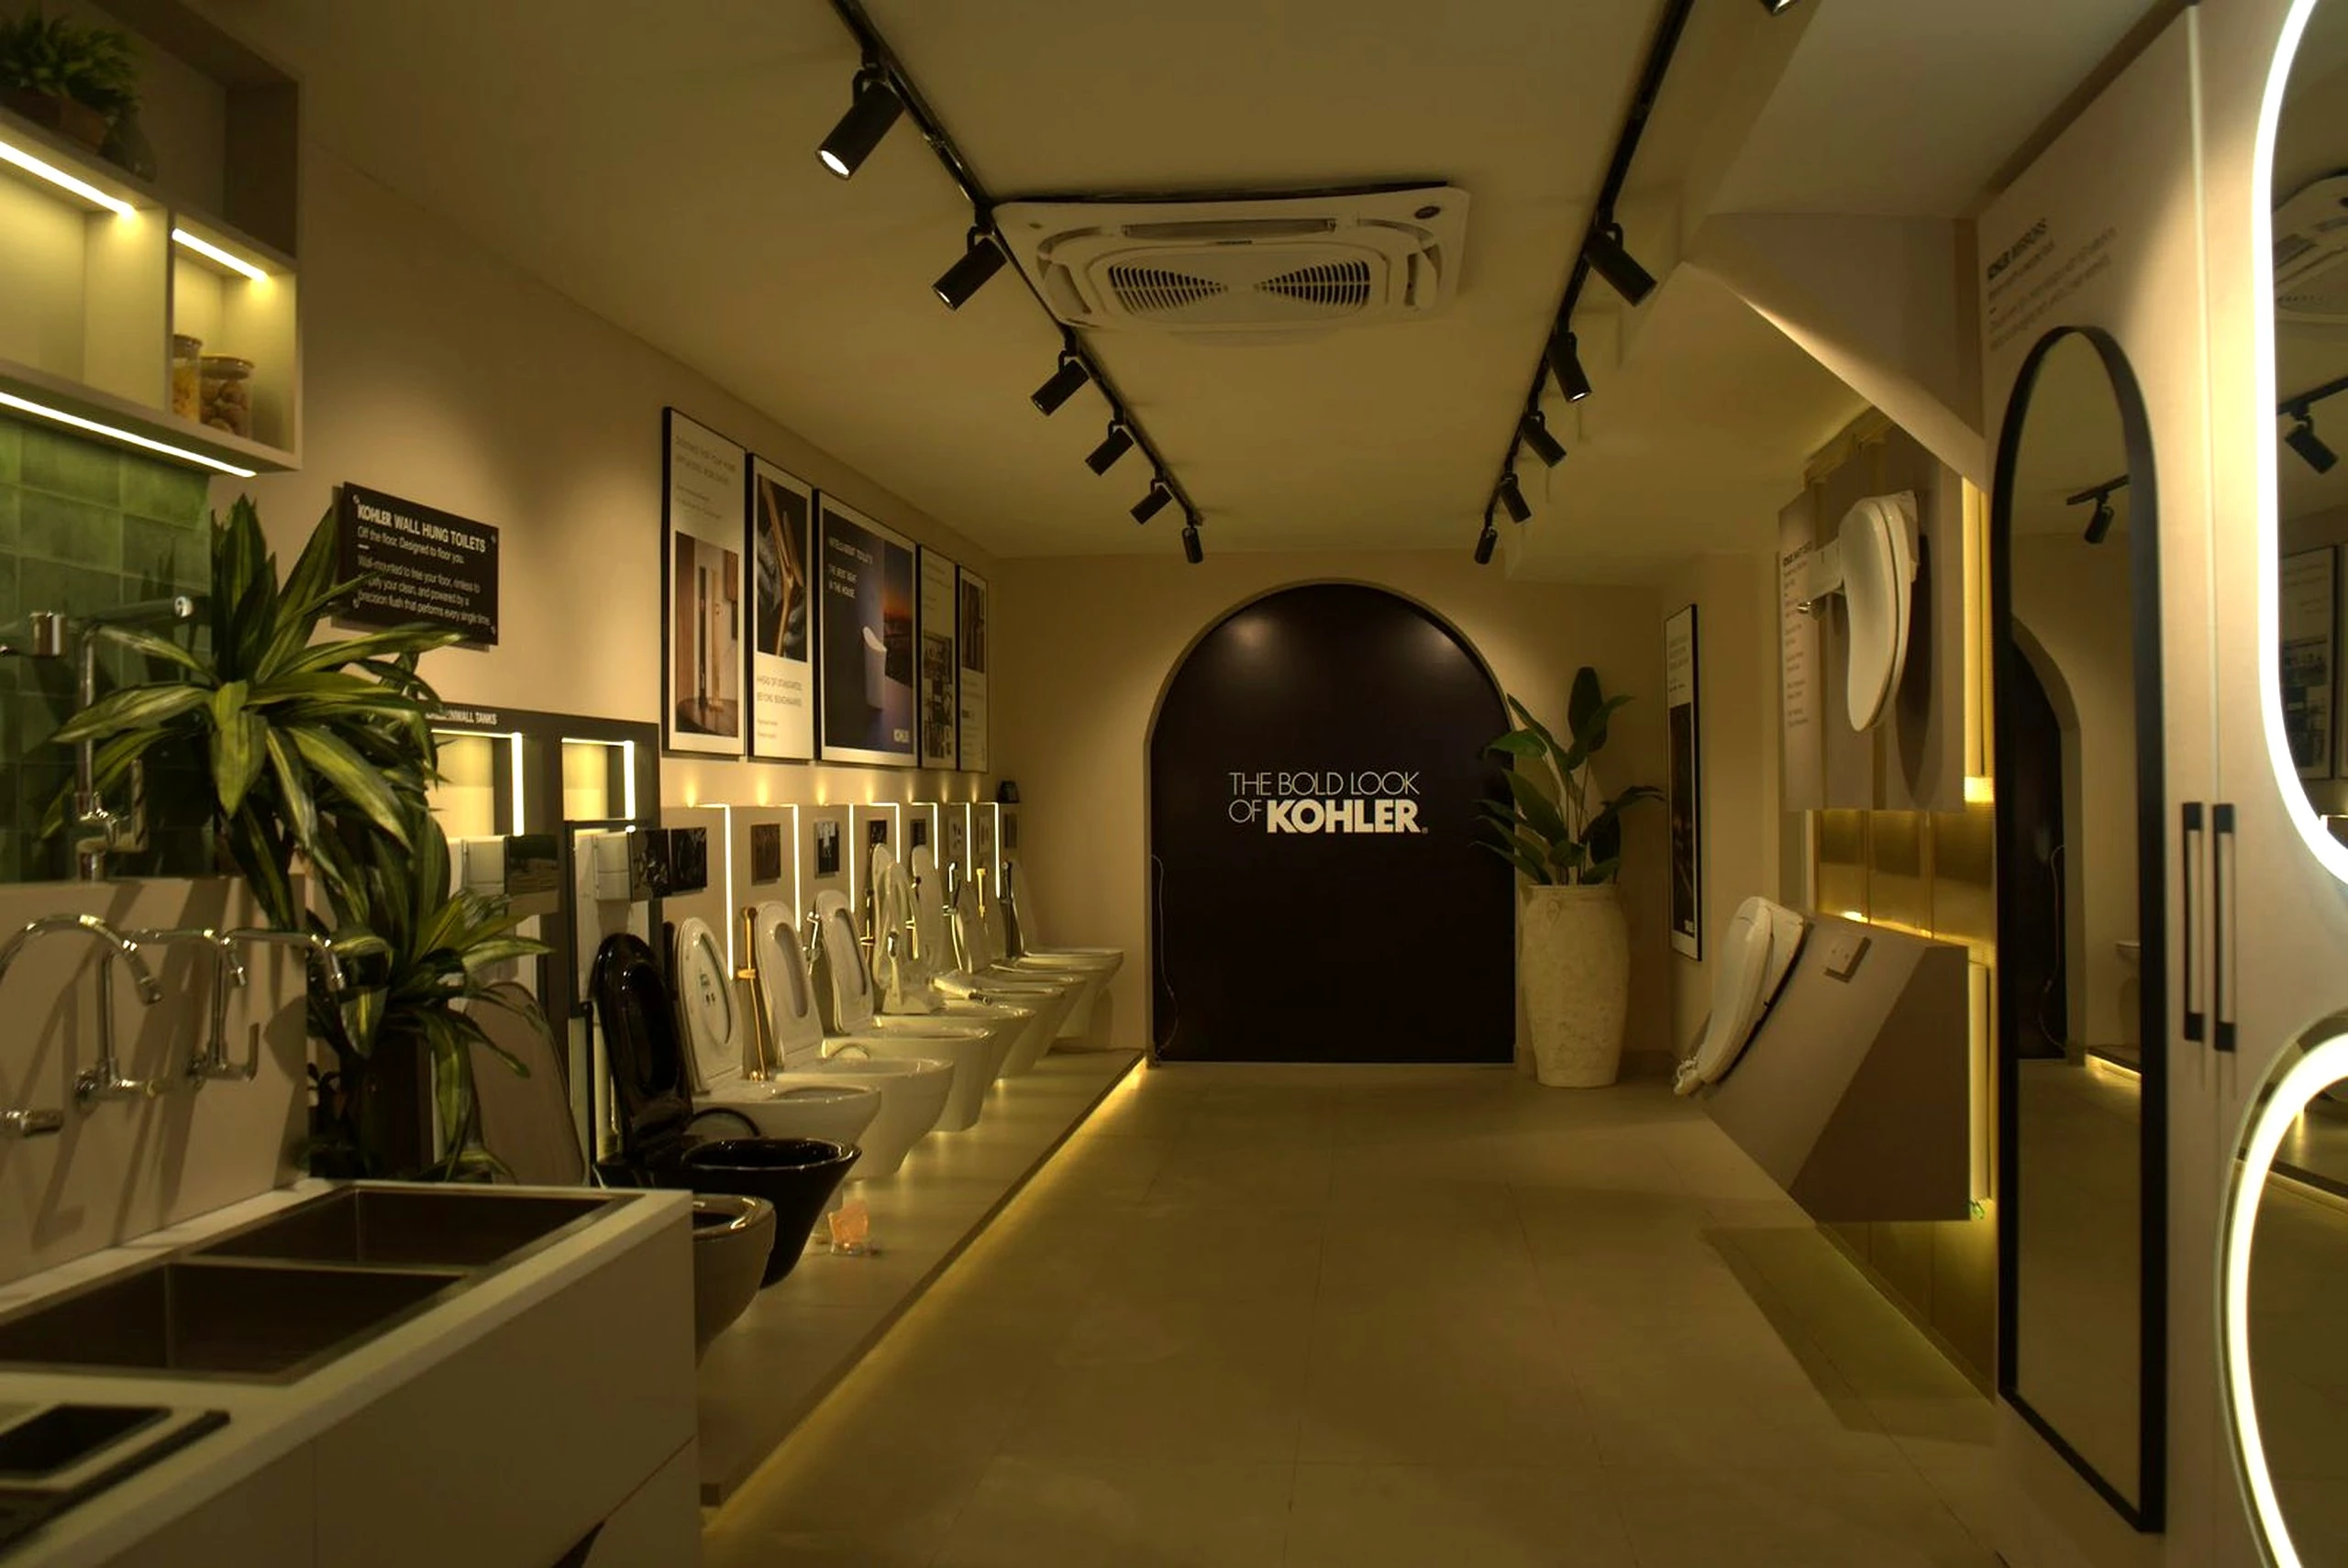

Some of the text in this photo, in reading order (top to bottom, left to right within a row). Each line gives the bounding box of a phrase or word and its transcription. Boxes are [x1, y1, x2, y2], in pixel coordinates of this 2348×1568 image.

[357, 504, 486, 553] KOHLER WALL HUNG TOILETS
[358, 525, 369, 538] Off
[370, 527, 381, 542] the
[399, 536, 429, 555] Designed
[429, 545, 437, 557] to
[437, 547, 450, 560] floor
[1228, 771, 1420, 796] THE BOLD LOOK
[1228, 799, 1262, 823] OF
